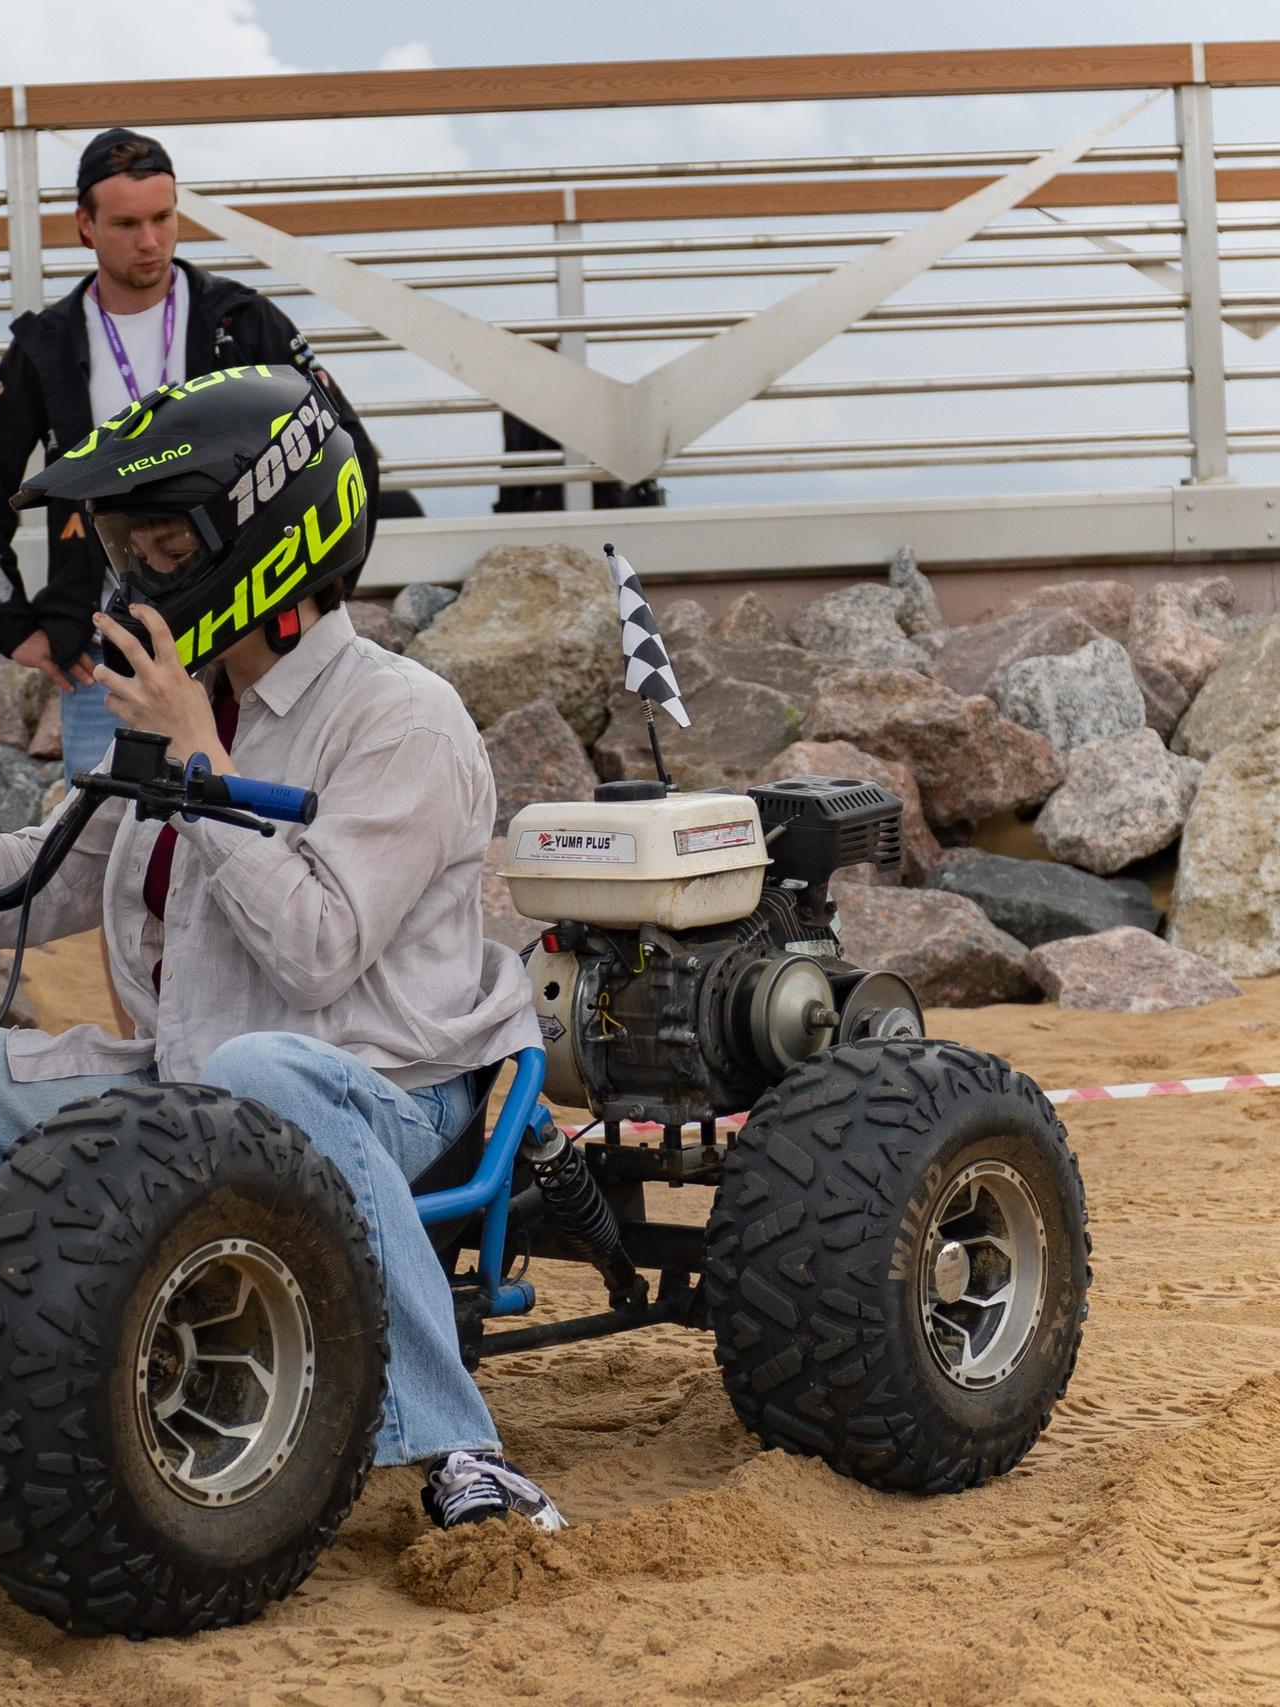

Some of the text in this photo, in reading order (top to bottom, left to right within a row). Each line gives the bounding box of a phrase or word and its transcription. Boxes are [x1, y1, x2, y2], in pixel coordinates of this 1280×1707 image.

[117, 443, 192, 477] HELMO
[228, 395, 334, 526] 100%
[555, 835, 611, 850] YUMA PLUS
[887, 1163, 943, 1280] WILD
